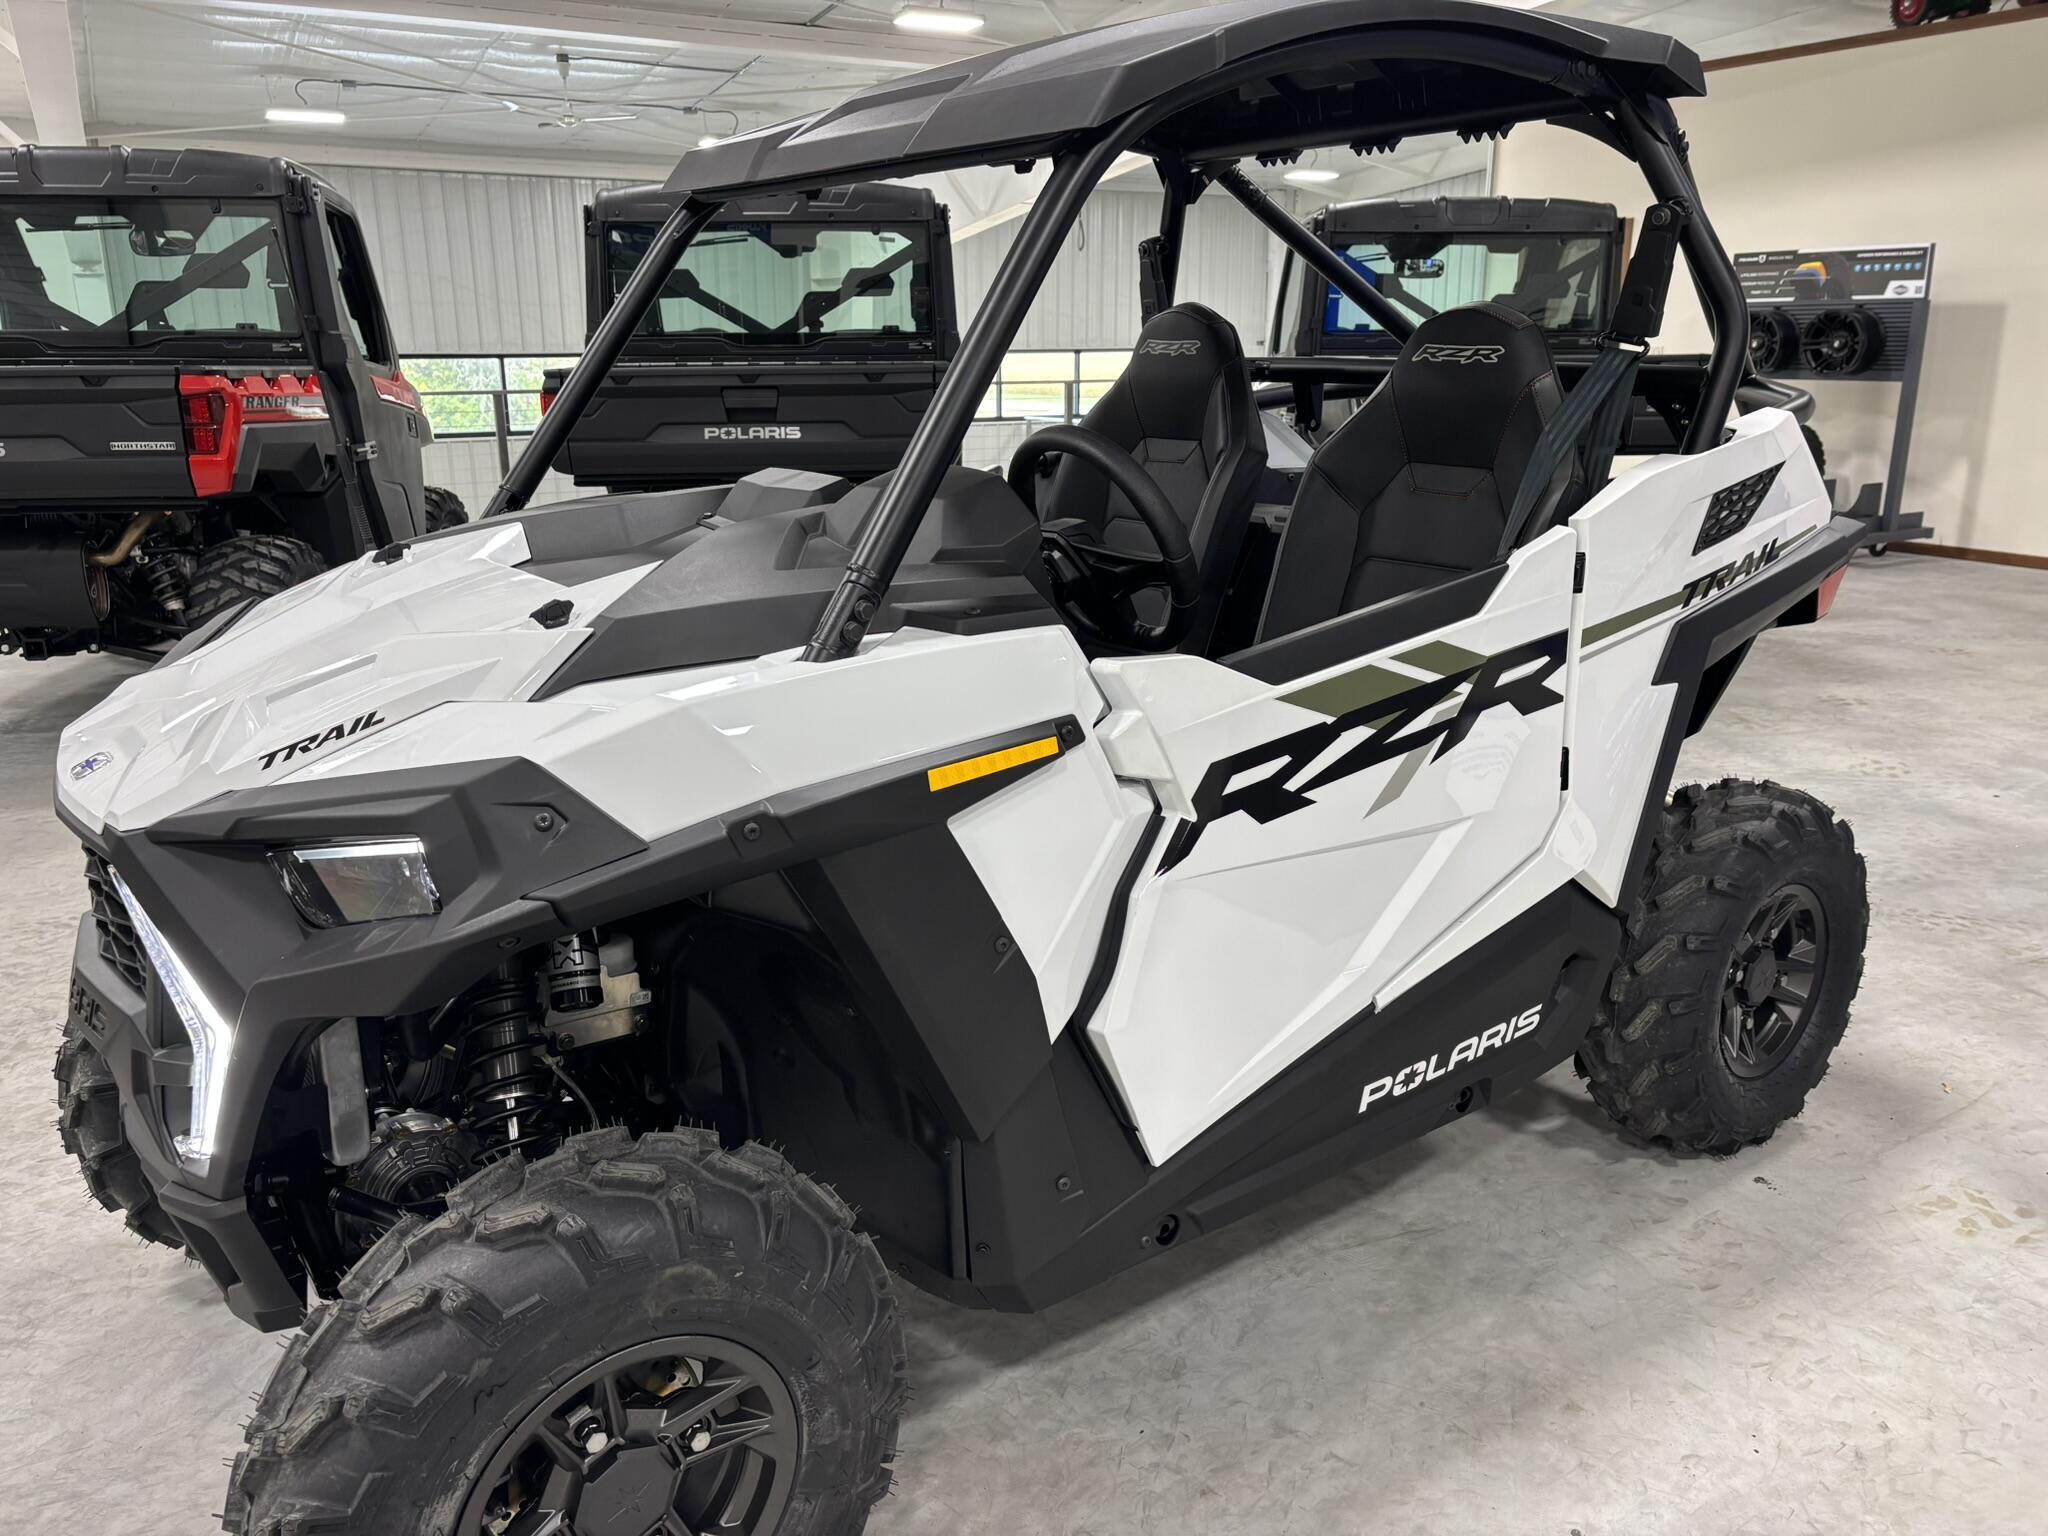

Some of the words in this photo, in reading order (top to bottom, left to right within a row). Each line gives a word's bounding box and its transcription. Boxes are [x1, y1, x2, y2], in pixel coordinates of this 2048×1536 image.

[1138, 339, 1200, 356] RZR
[1412, 344, 1505, 364] RZR
[246, 395, 300, 409] RANGER
[704, 426, 802, 440] POLARIS
[110, 442, 176, 450] NORTHSTAR
[1681, 537, 1781, 610] TRAIL
[258, 709, 386, 772] TRAIL
[1155, 628, 1568, 877] RZR
[1358, 1003, 1543, 1114] POLARIS
